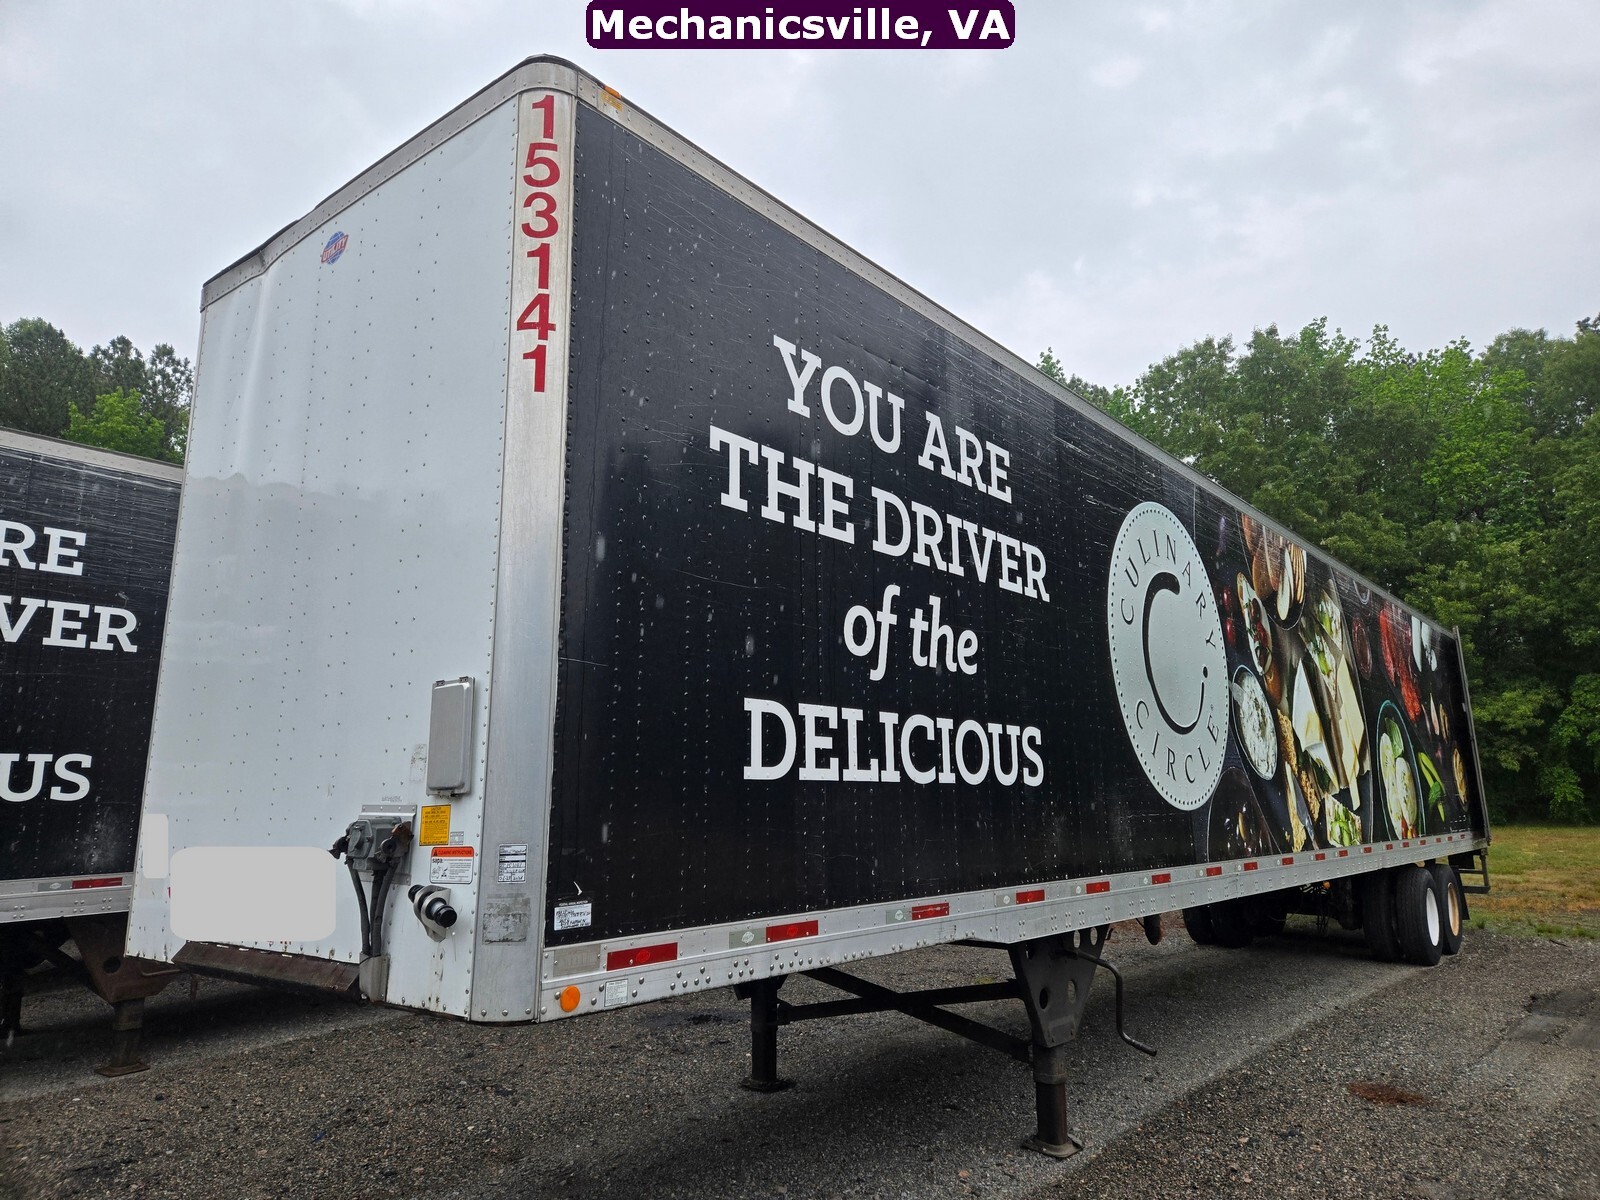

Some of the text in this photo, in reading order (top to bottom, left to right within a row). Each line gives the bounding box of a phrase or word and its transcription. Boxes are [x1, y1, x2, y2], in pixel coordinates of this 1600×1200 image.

[516, 94, 560, 393] 153141
[773, 334, 1012, 504] YOU ARE
[709, 425, 1050, 603] THE DRIVER
[843, 584, 979, 681] of the
[1120, 529, 1218, 650] CULINARY
[743, 697, 1044, 787] DELICIOUS
[1136, 699, 1220, 784] CIRCLE
